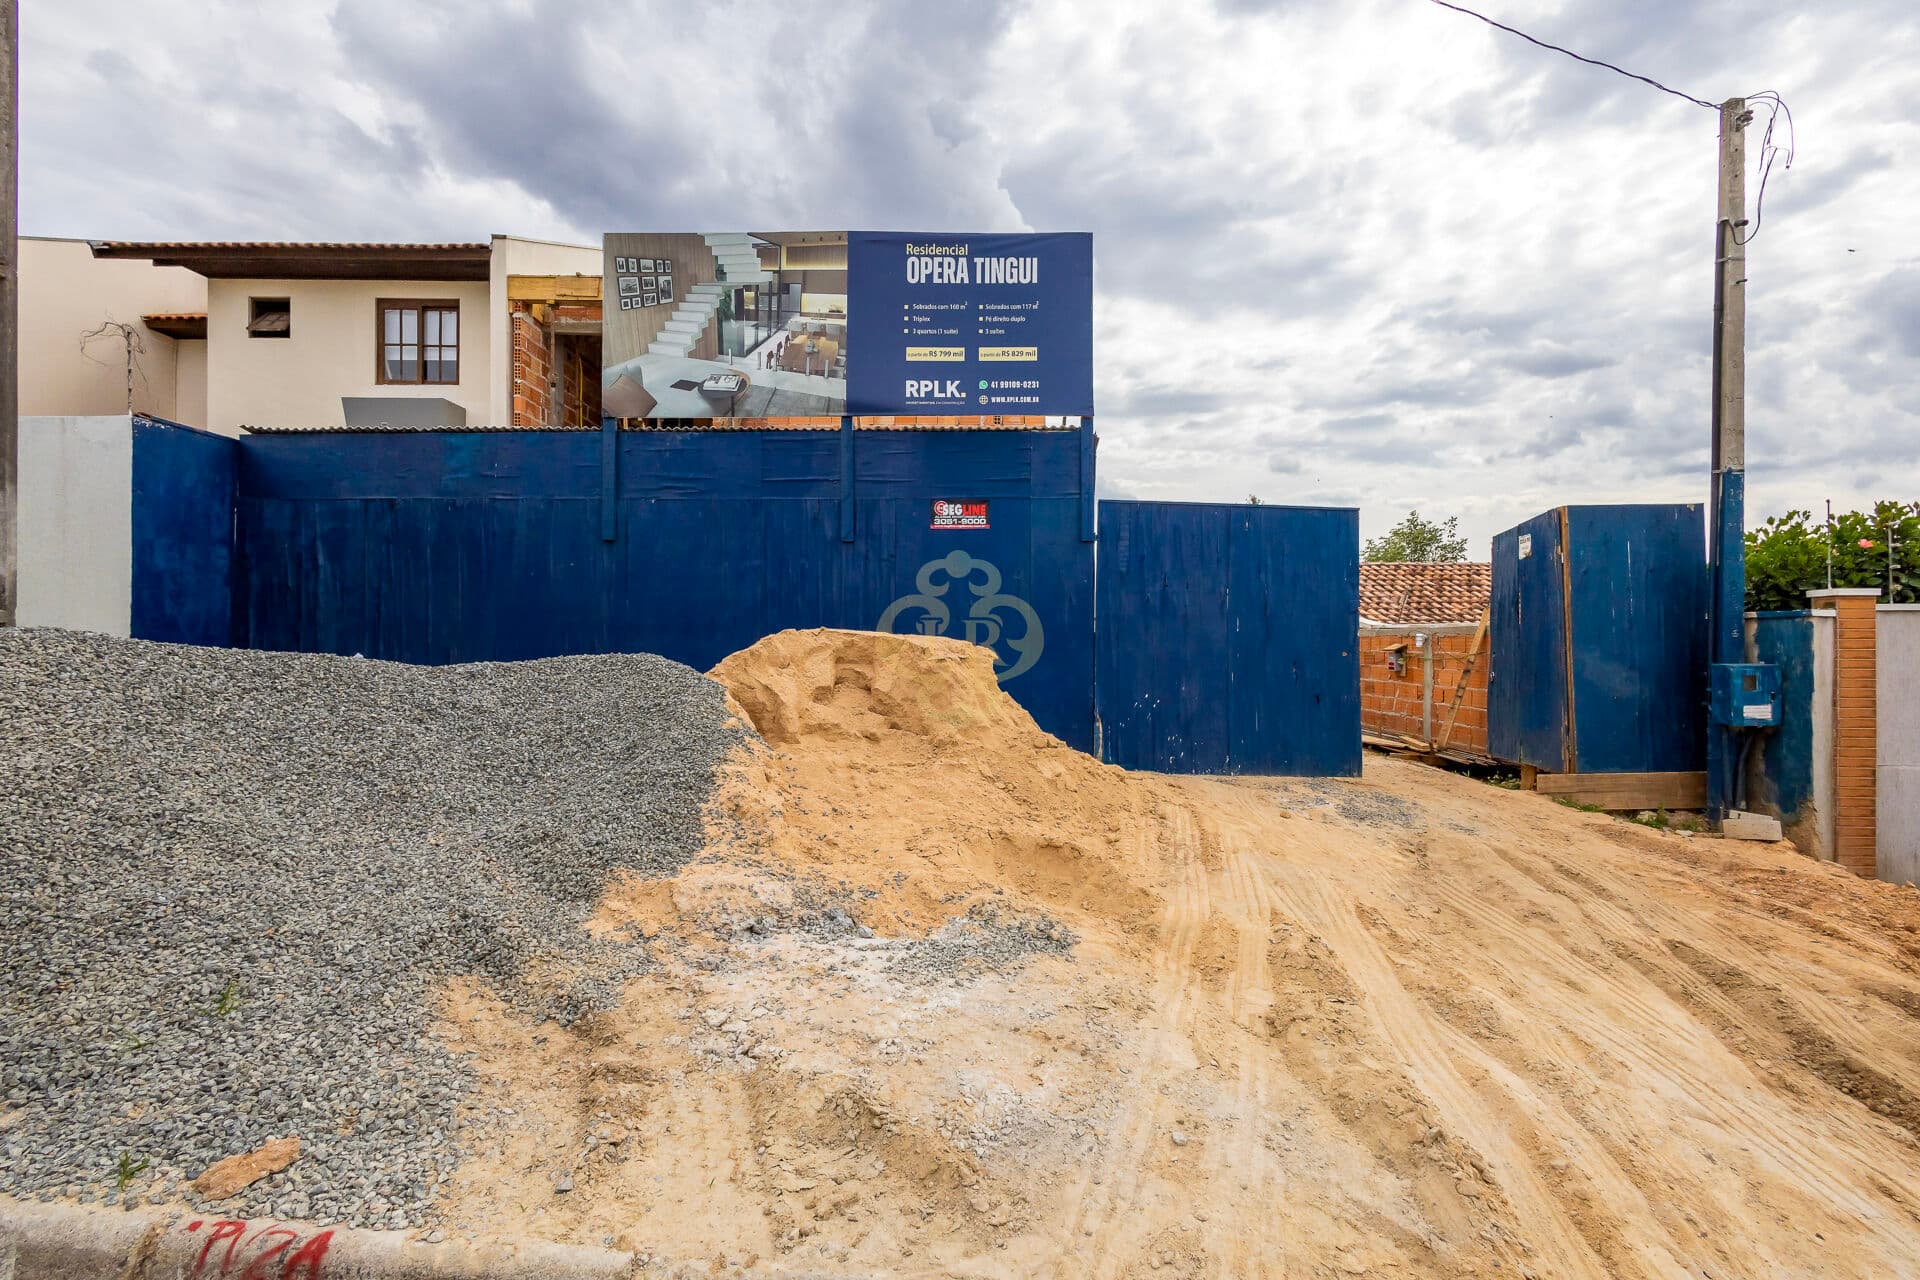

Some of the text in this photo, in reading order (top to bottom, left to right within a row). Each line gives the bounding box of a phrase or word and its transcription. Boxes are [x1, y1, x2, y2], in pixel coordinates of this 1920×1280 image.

[906, 244, 968, 255] Residencial
[906, 256, 1038, 284] OPERA TINGUI
[991, 380, 998, 389] 41
